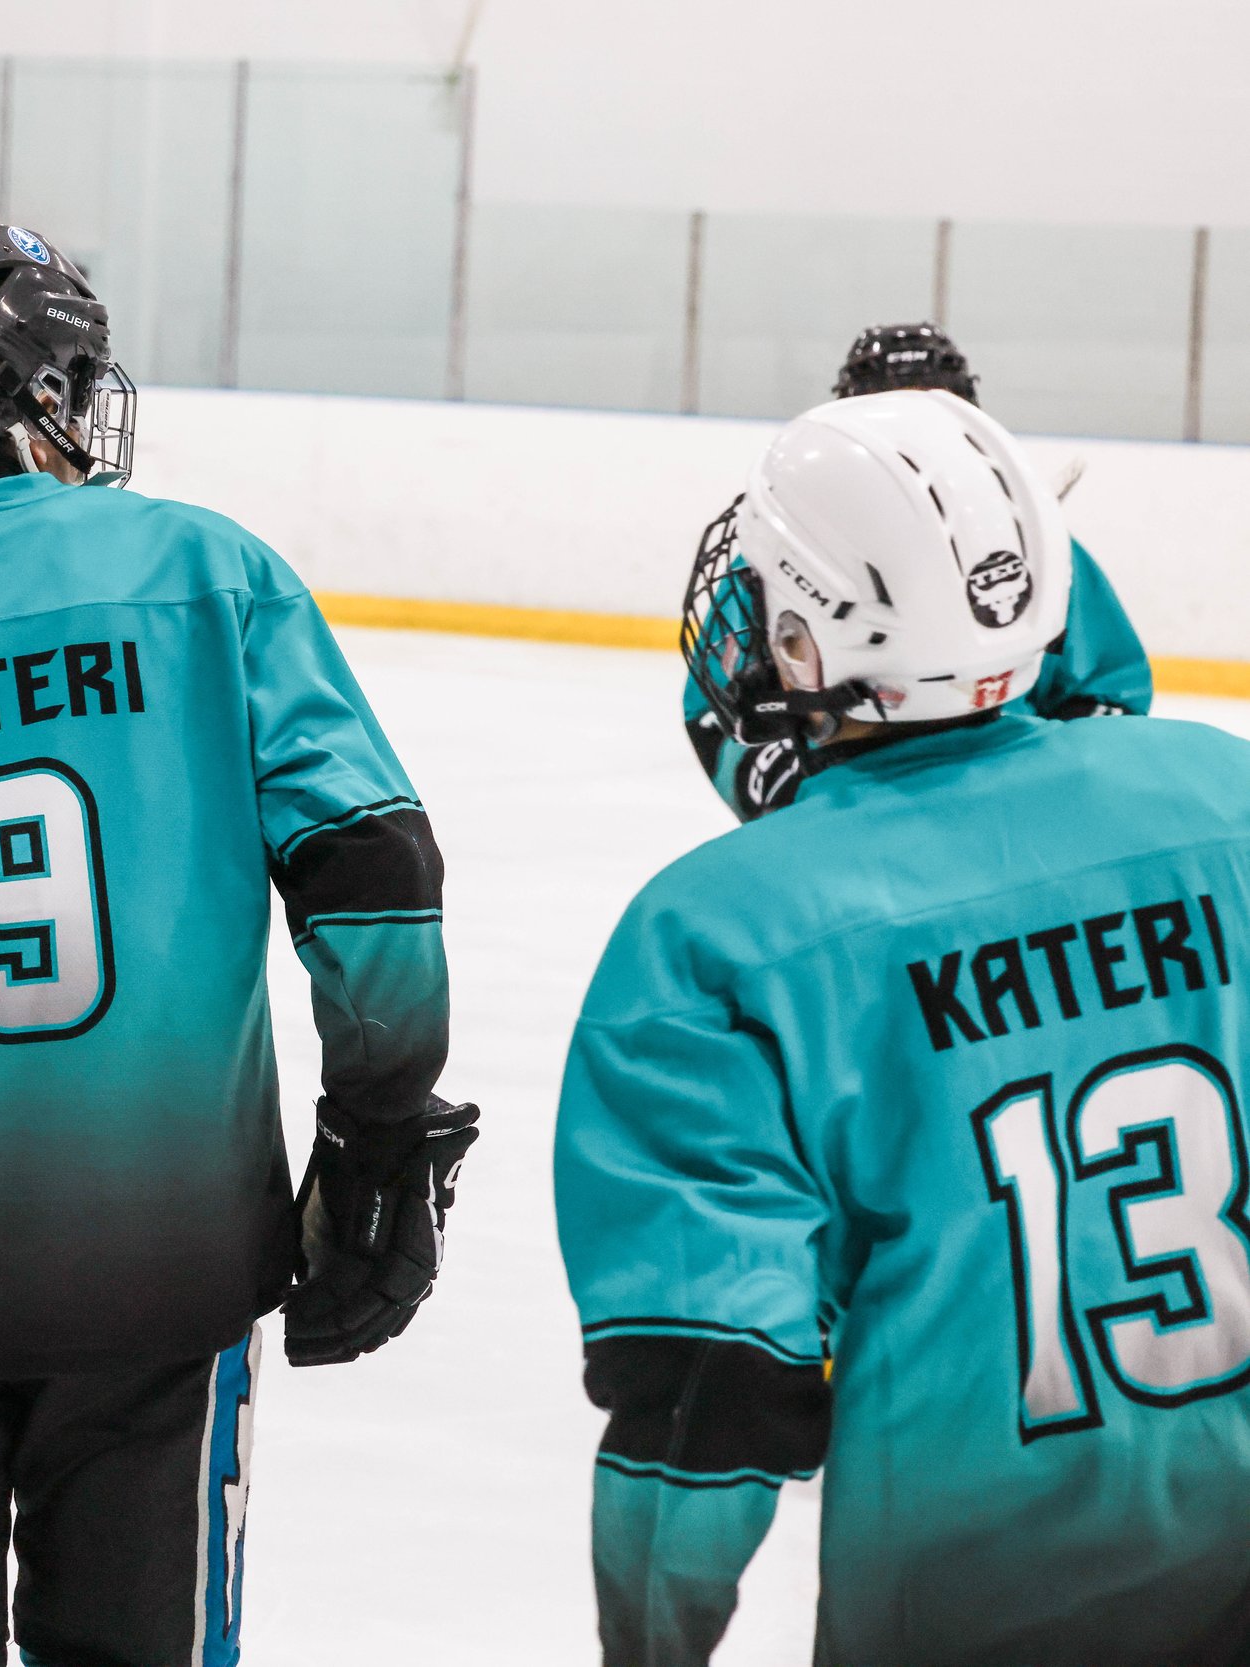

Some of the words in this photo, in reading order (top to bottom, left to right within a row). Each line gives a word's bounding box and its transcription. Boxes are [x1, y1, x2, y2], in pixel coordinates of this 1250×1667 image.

[46, 307, 91, 331] BAUER
[38, 416, 75, 453] BAUER
[779, 559, 829, 607] CCM
[748, 738, 793, 805] CC
[906, 894, 1231, 1052] KATERI
[969, 1043, 1250, 1446] 13
